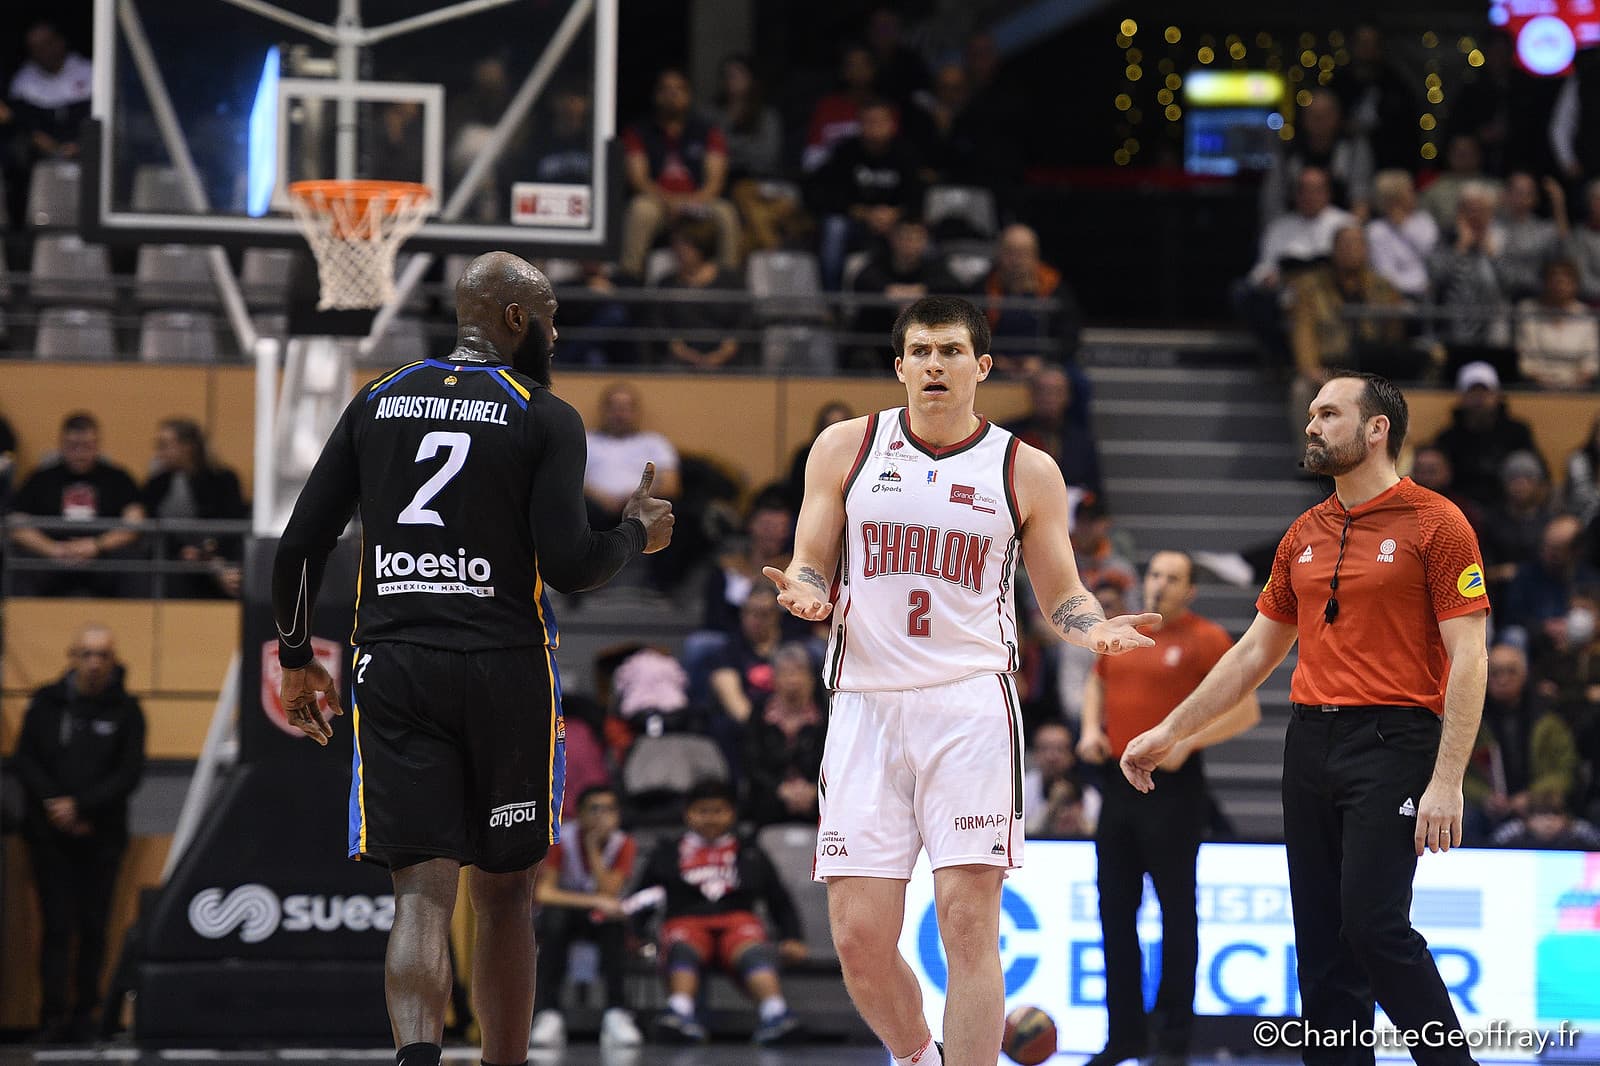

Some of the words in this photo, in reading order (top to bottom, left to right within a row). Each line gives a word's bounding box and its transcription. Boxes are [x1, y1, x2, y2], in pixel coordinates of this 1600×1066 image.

[375, 396, 449, 420] AUGUSTIN
[450, 398, 508, 426] FAIRELL
[397, 431, 471, 527] 2
[881, 484, 902, 493] Sports
[375, 544, 491, 582] koesio
[860, 521, 994, 595] CHALON
[381, 582, 434, 593] CONNEXION
[907, 589, 932, 638] 2
[489, 807, 536, 828] anjou
[821, 844, 849, 857] JOA
[282, 894, 395, 931] suez
